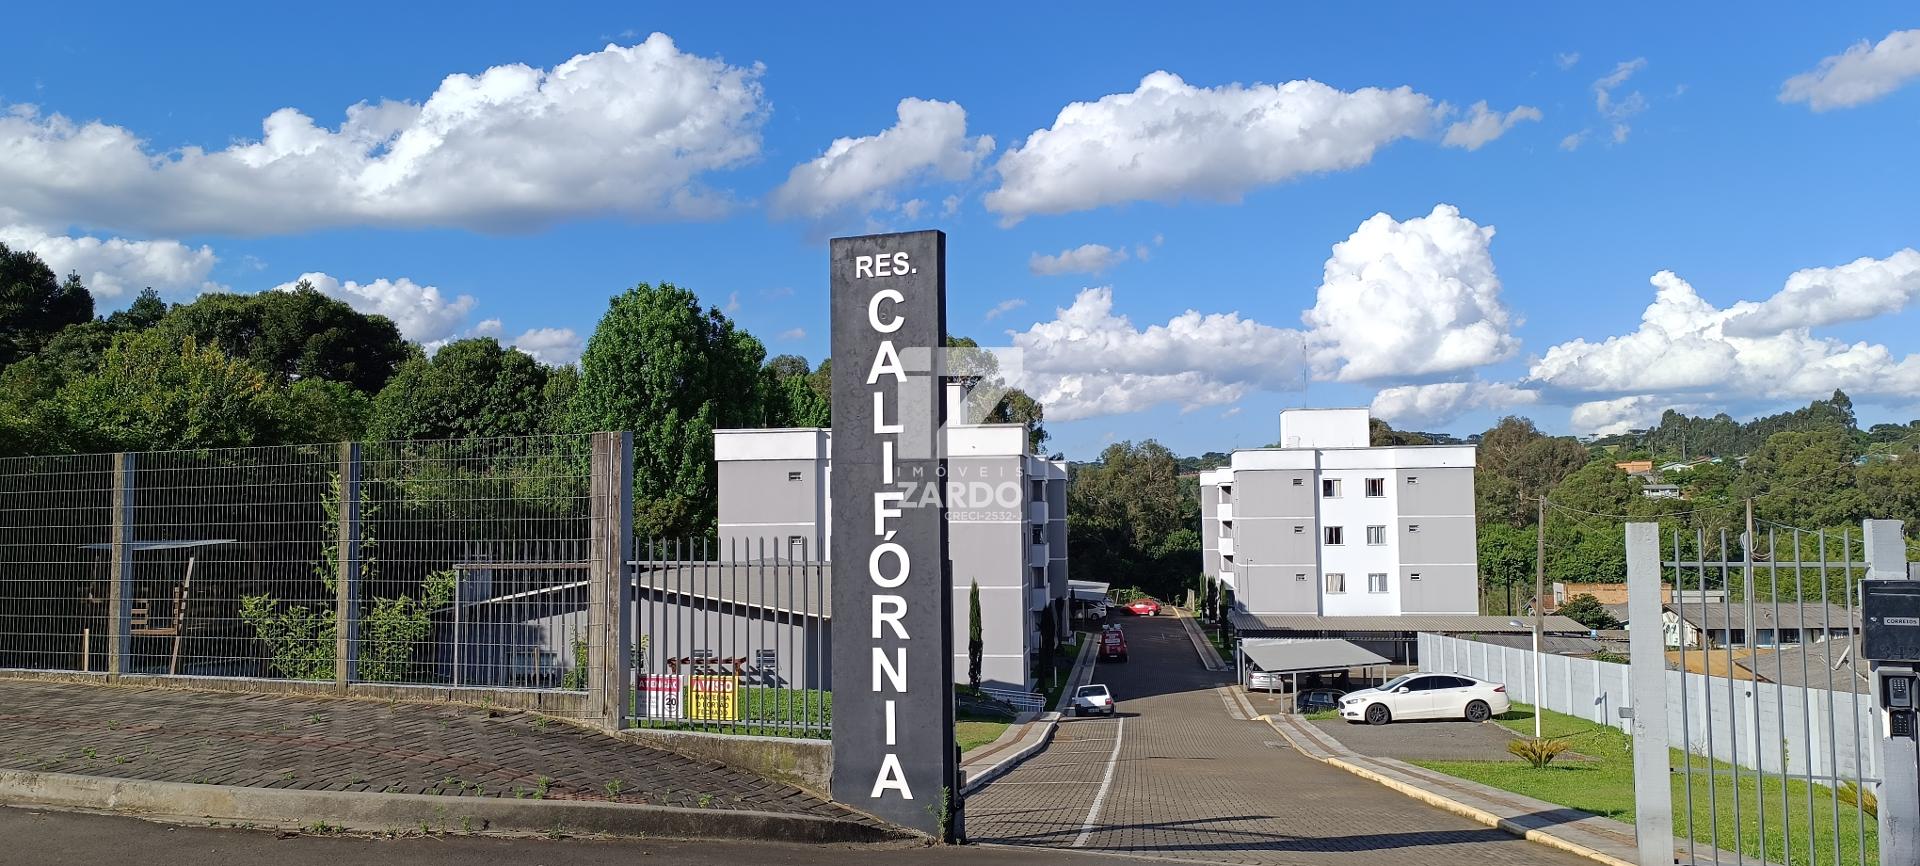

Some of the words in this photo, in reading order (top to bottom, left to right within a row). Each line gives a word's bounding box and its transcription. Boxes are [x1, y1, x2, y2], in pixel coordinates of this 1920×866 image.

[855, 251, 918, 279] RES.
[866, 288, 913, 800] CALIFÓRNIA
[692, 680, 733, 692] AVISO
[665, 697, 677, 706] 20
